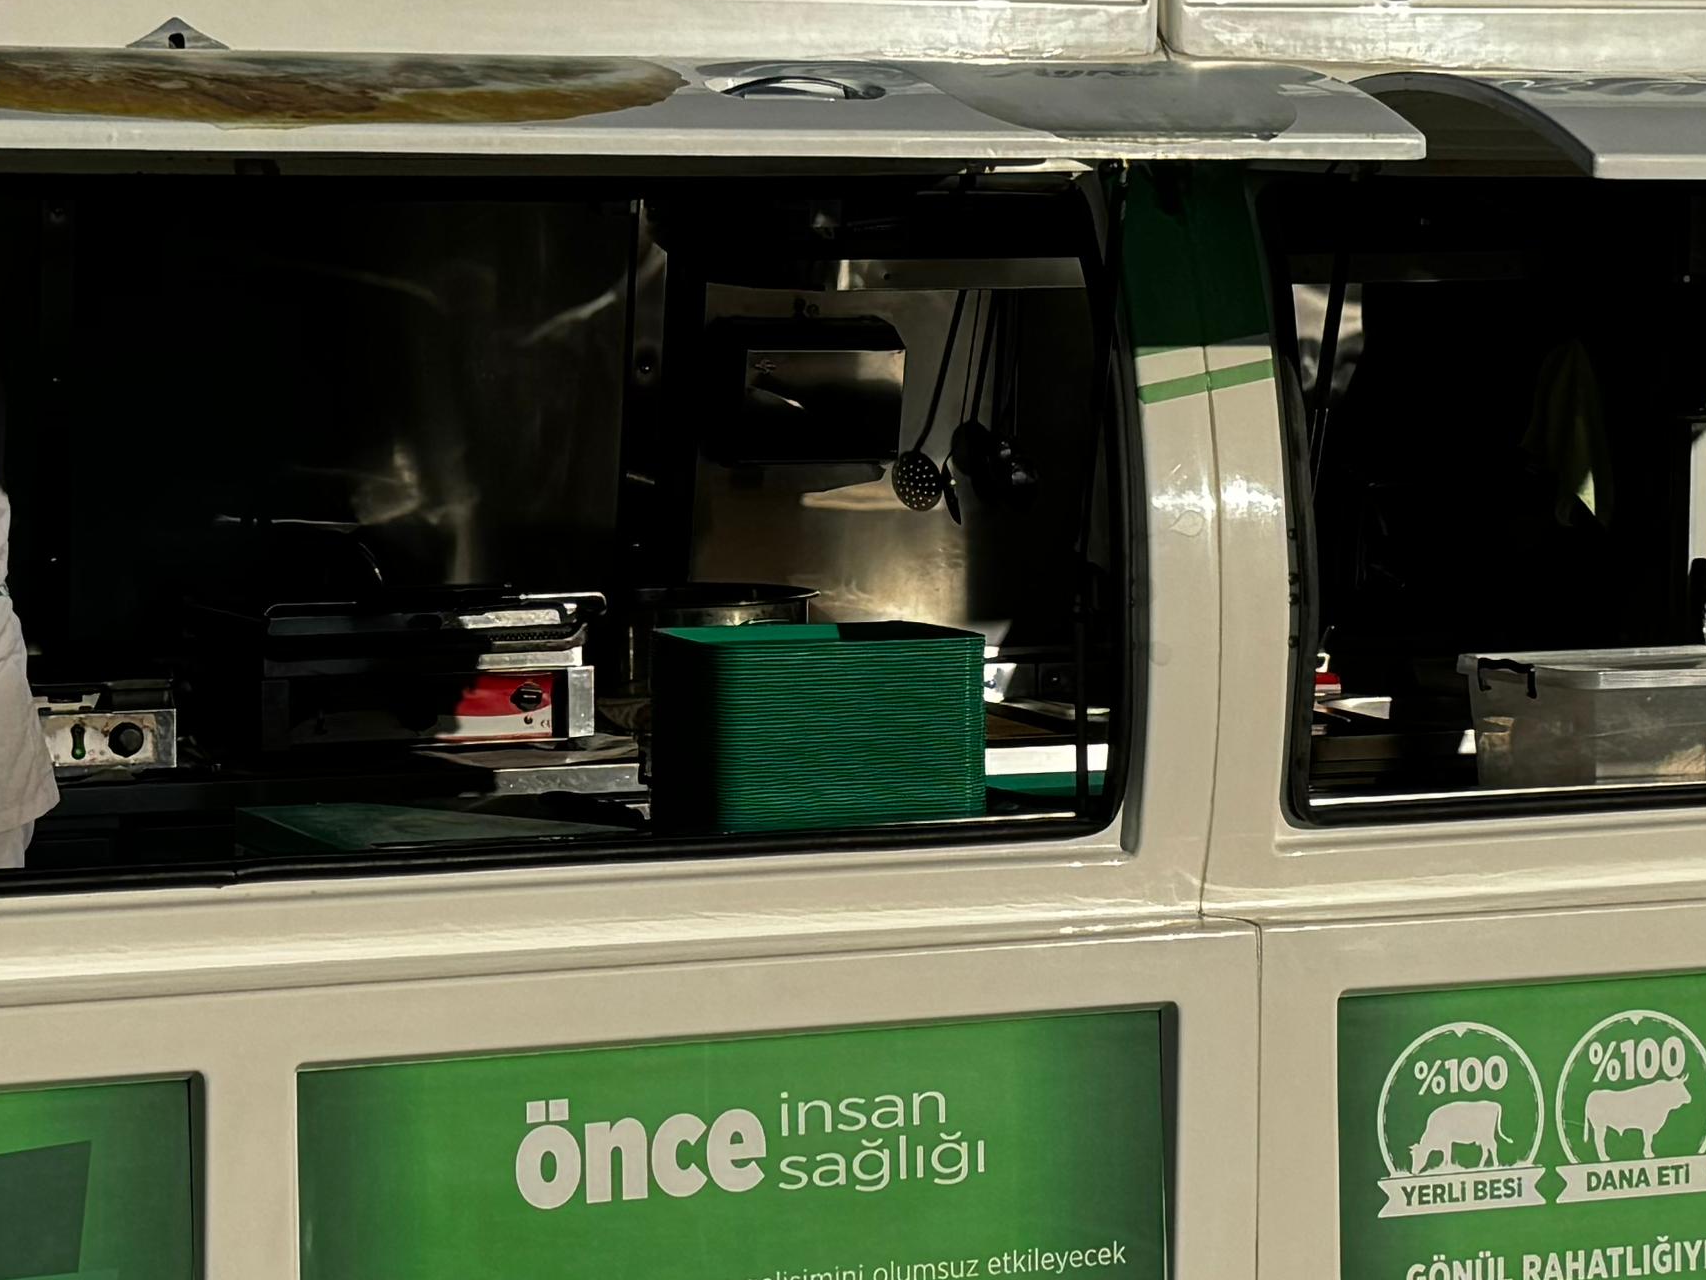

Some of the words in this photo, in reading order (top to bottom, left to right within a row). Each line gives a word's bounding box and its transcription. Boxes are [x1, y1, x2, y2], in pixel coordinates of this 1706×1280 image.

[1413, 1055, 1509, 1096] %100
[1588, 1035, 1687, 1083] %100
[779, 1088, 949, 1138] insan
[515, 1098, 768, 1211] önce
[778, 1134, 988, 1193] sağlığı
[1401, 1179, 1467, 1207] YERLİ
[1473, 1176, 1524, 1202] BESİ
[1586, 1167, 1651, 1192] DANA
[1657, 1163, 1691, 1187] ETİ
[987, 1240, 1127, 1275] etkileyecek
